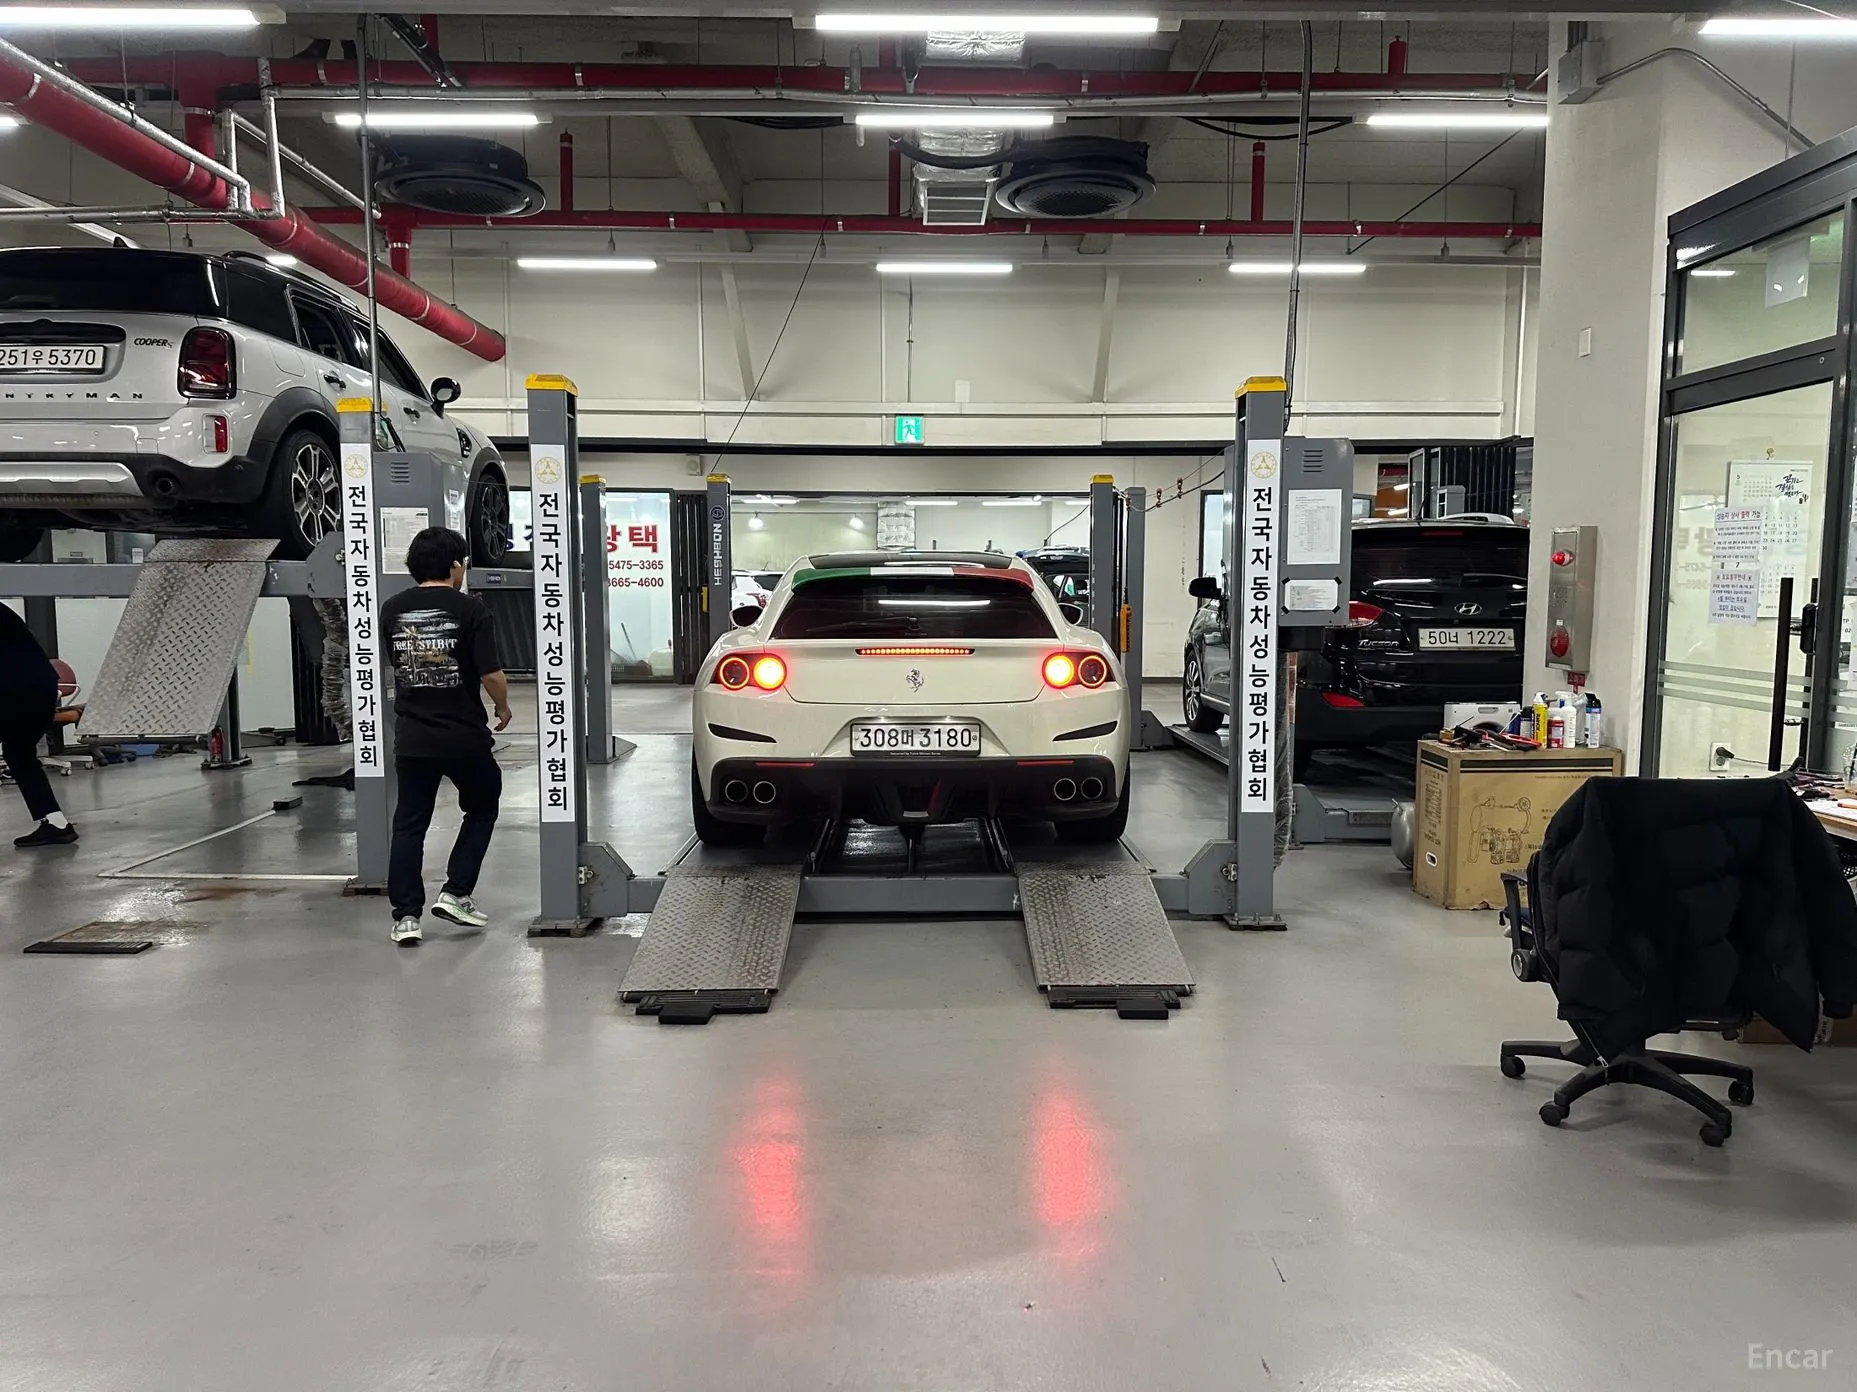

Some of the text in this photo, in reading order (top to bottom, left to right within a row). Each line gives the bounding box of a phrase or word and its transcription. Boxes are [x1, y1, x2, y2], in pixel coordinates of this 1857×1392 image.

[134, 337, 168, 346] COOPER
[48, 349, 96, 365] 5370
[713, 523, 723, 586] HESHBON
[609, 560, 664, 570] 5475-3365
[348, 486, 378, 767] 전국자동차성능평가협회
[1247, 487, 1273, 802] 전국자동차성능평가협회
[1428, 630, 1506, 645] 50너 1222
[539, 492, 568, 811] 전국자동차성능평가협회
[860, 728, 972, 747] 308머 3180
